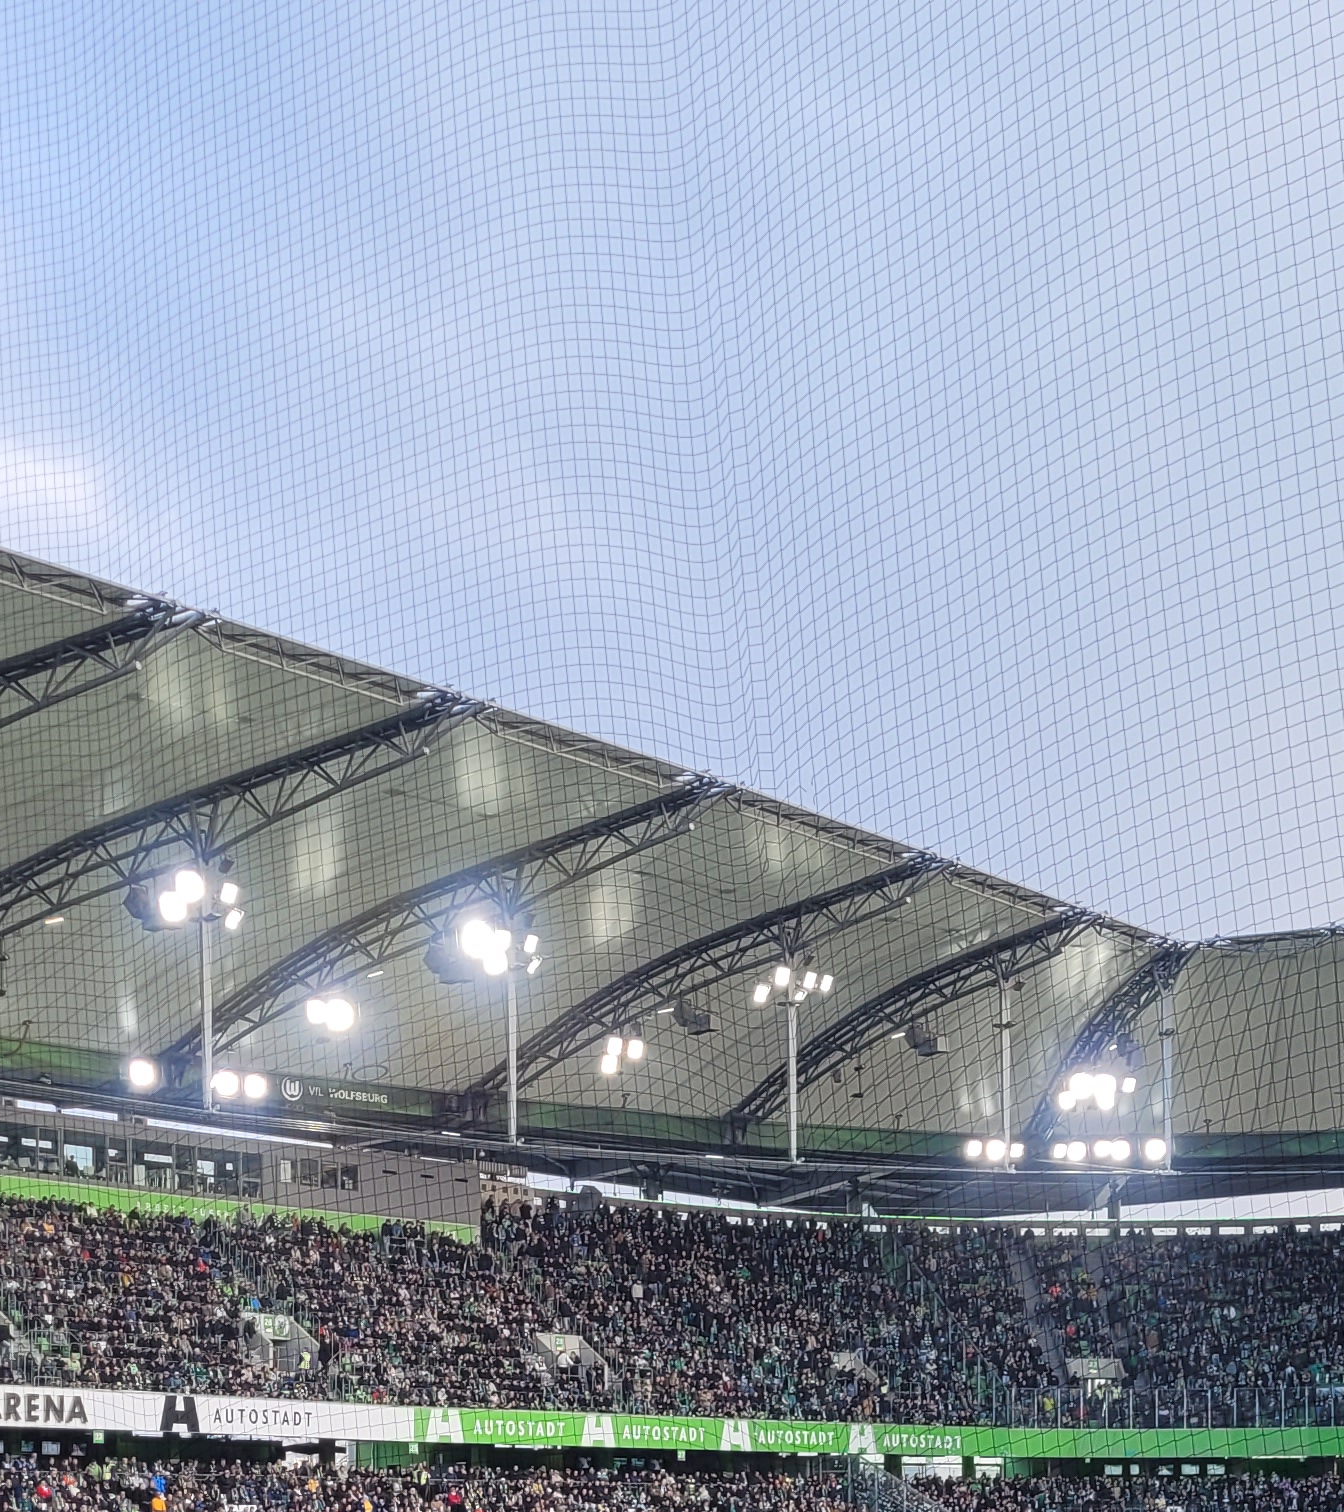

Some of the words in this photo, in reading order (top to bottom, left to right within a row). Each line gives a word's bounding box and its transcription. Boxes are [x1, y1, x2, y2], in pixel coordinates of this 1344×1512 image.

[328, 1088, 388, 1104] WOLFSBURG
[213, 1407, 313, 1427] AUTOSTADT
[474, 1419, 566, 1437] AUTOSTADT
[623, 1424, 706, 1443] AUTOSTADT
[758, 1429, 835, 1446] AUTOSTADT
[883, 1432, 962, 1450] AUTOSTADT
